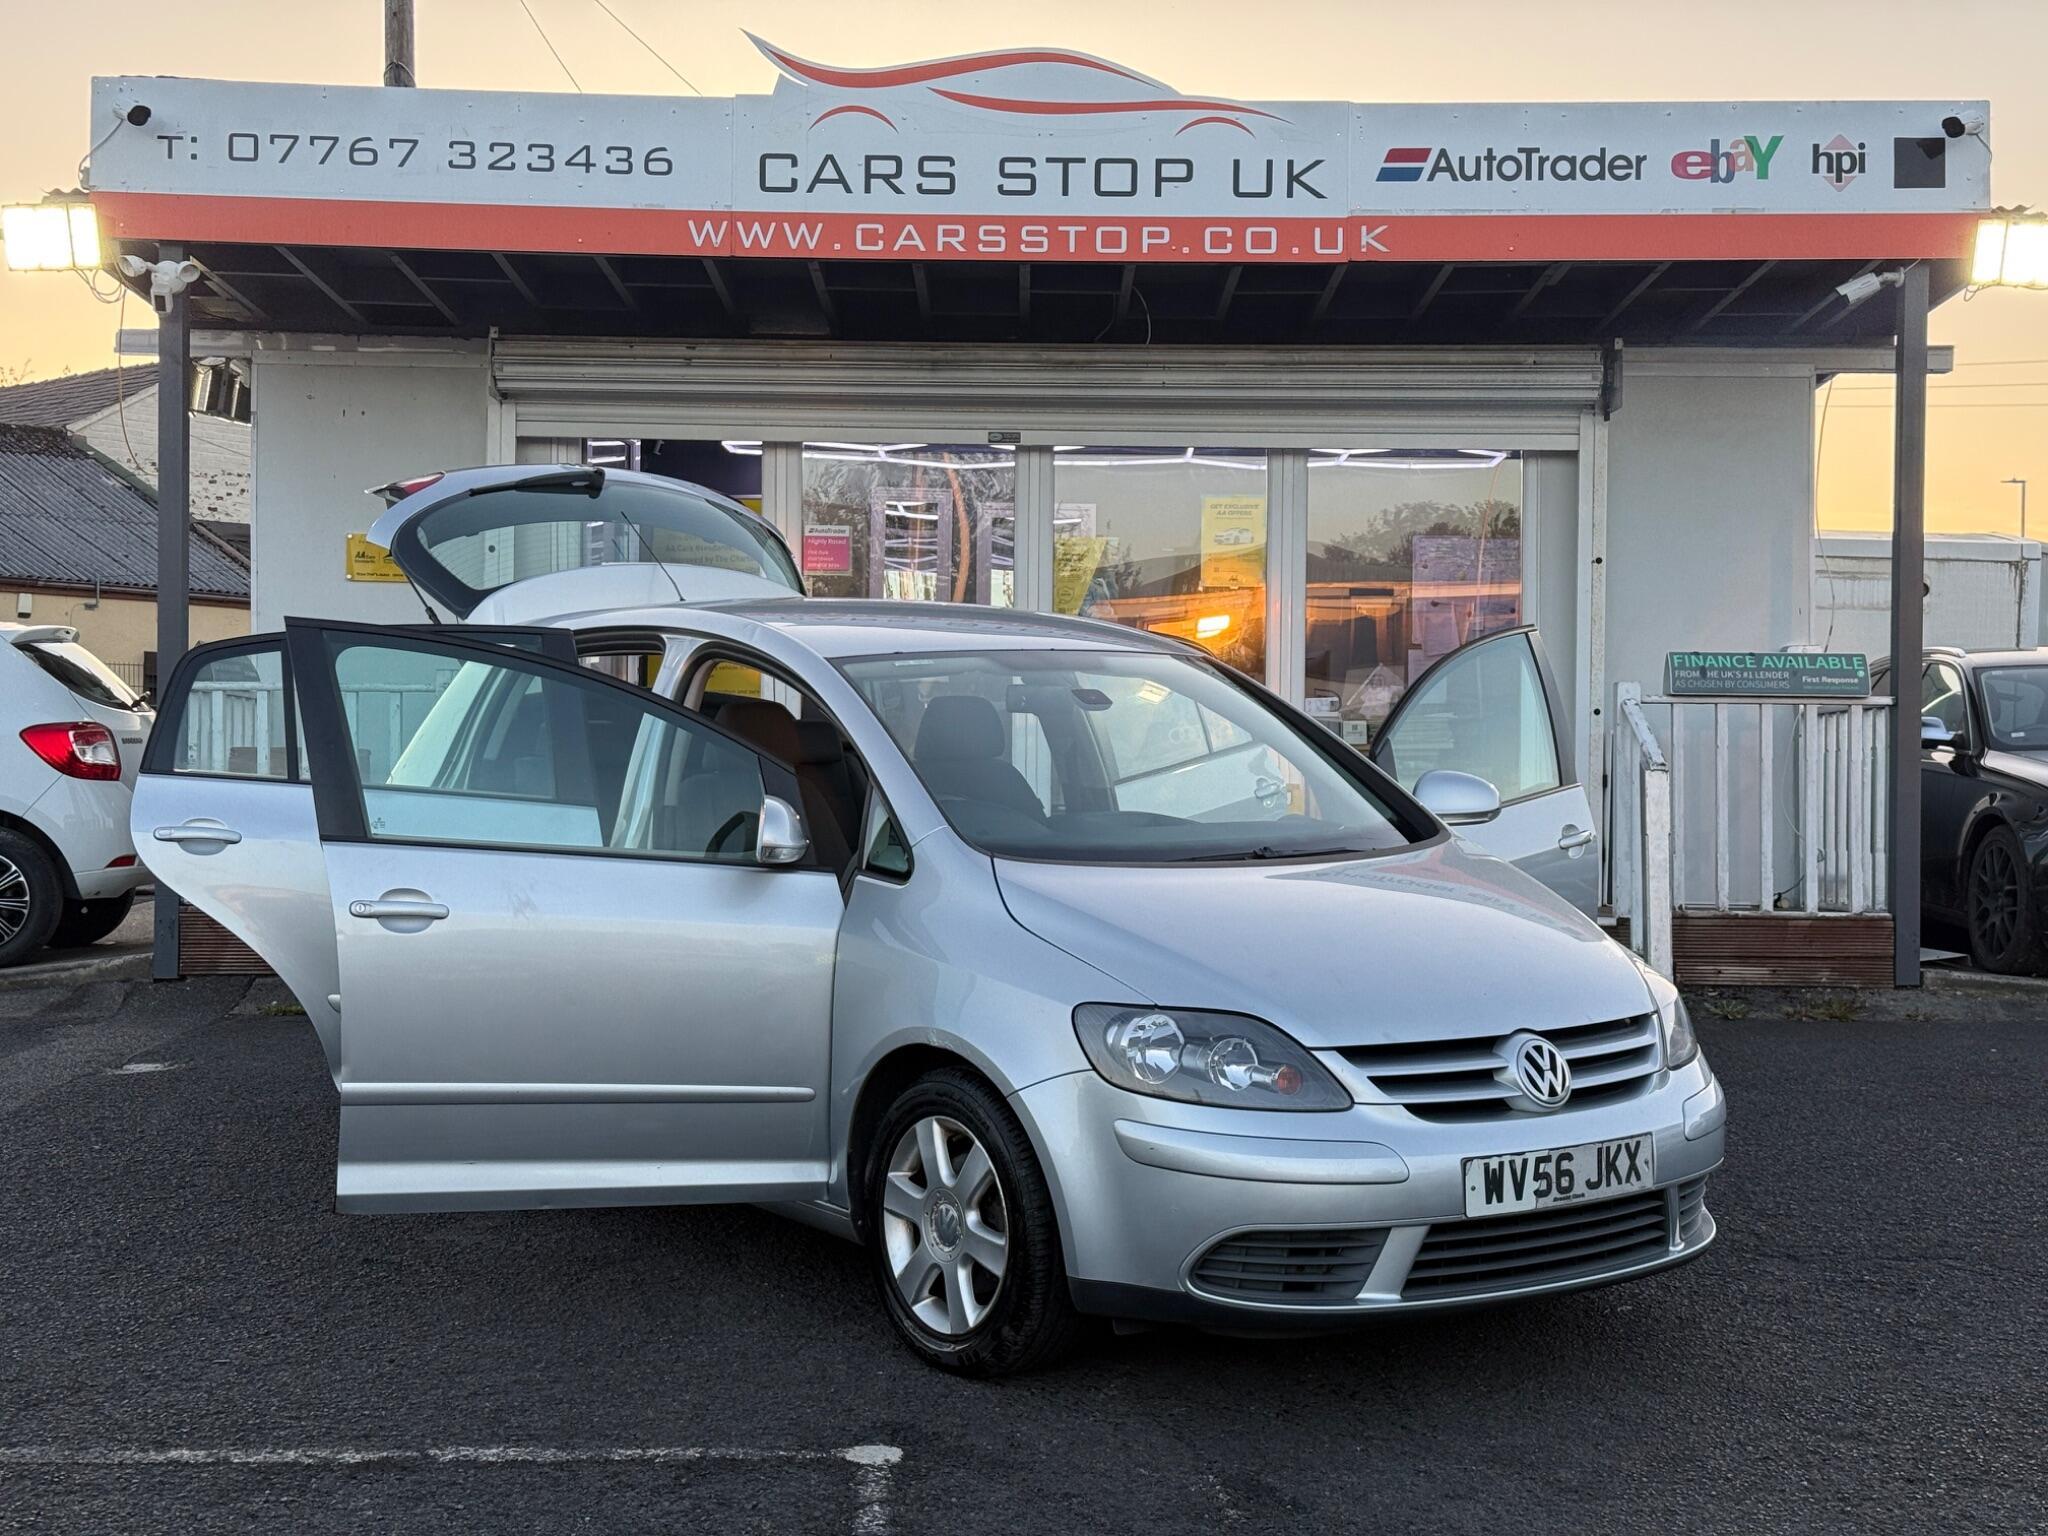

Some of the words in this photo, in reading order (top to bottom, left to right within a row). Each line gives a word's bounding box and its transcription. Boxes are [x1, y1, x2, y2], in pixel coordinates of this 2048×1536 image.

[157, 135, 199, 161] T:
[228, 132, 420, 169] 07767
[447, 140, 674, 177] 323436
[1428, 146, 1647, 183] AutoTrader
[1811, 141, 1867, 184] hpi
[759, 152, 957, 195] CARS
[997, 156, 1194, 198] STOP
[1232, 158, 1328, 200] UK
[687, 219, 1392, 256] WWW.CARSSTOP.CO.UK
[1673, 655, 1757, 668] FINANCE
[1762, 655, 1865, 670] AVAILABLE
[1754, 671, 1790, 680] LENDER
[1822, 676, 1859, 685] Response
[1688, 680, 1724, 688] CHOSEN
[1737, 681, 1790, 689] CONSUMERS
[1483, 1151, 1575, 1205] WV56
[1585, 1140, 1642, 1191] JKX
